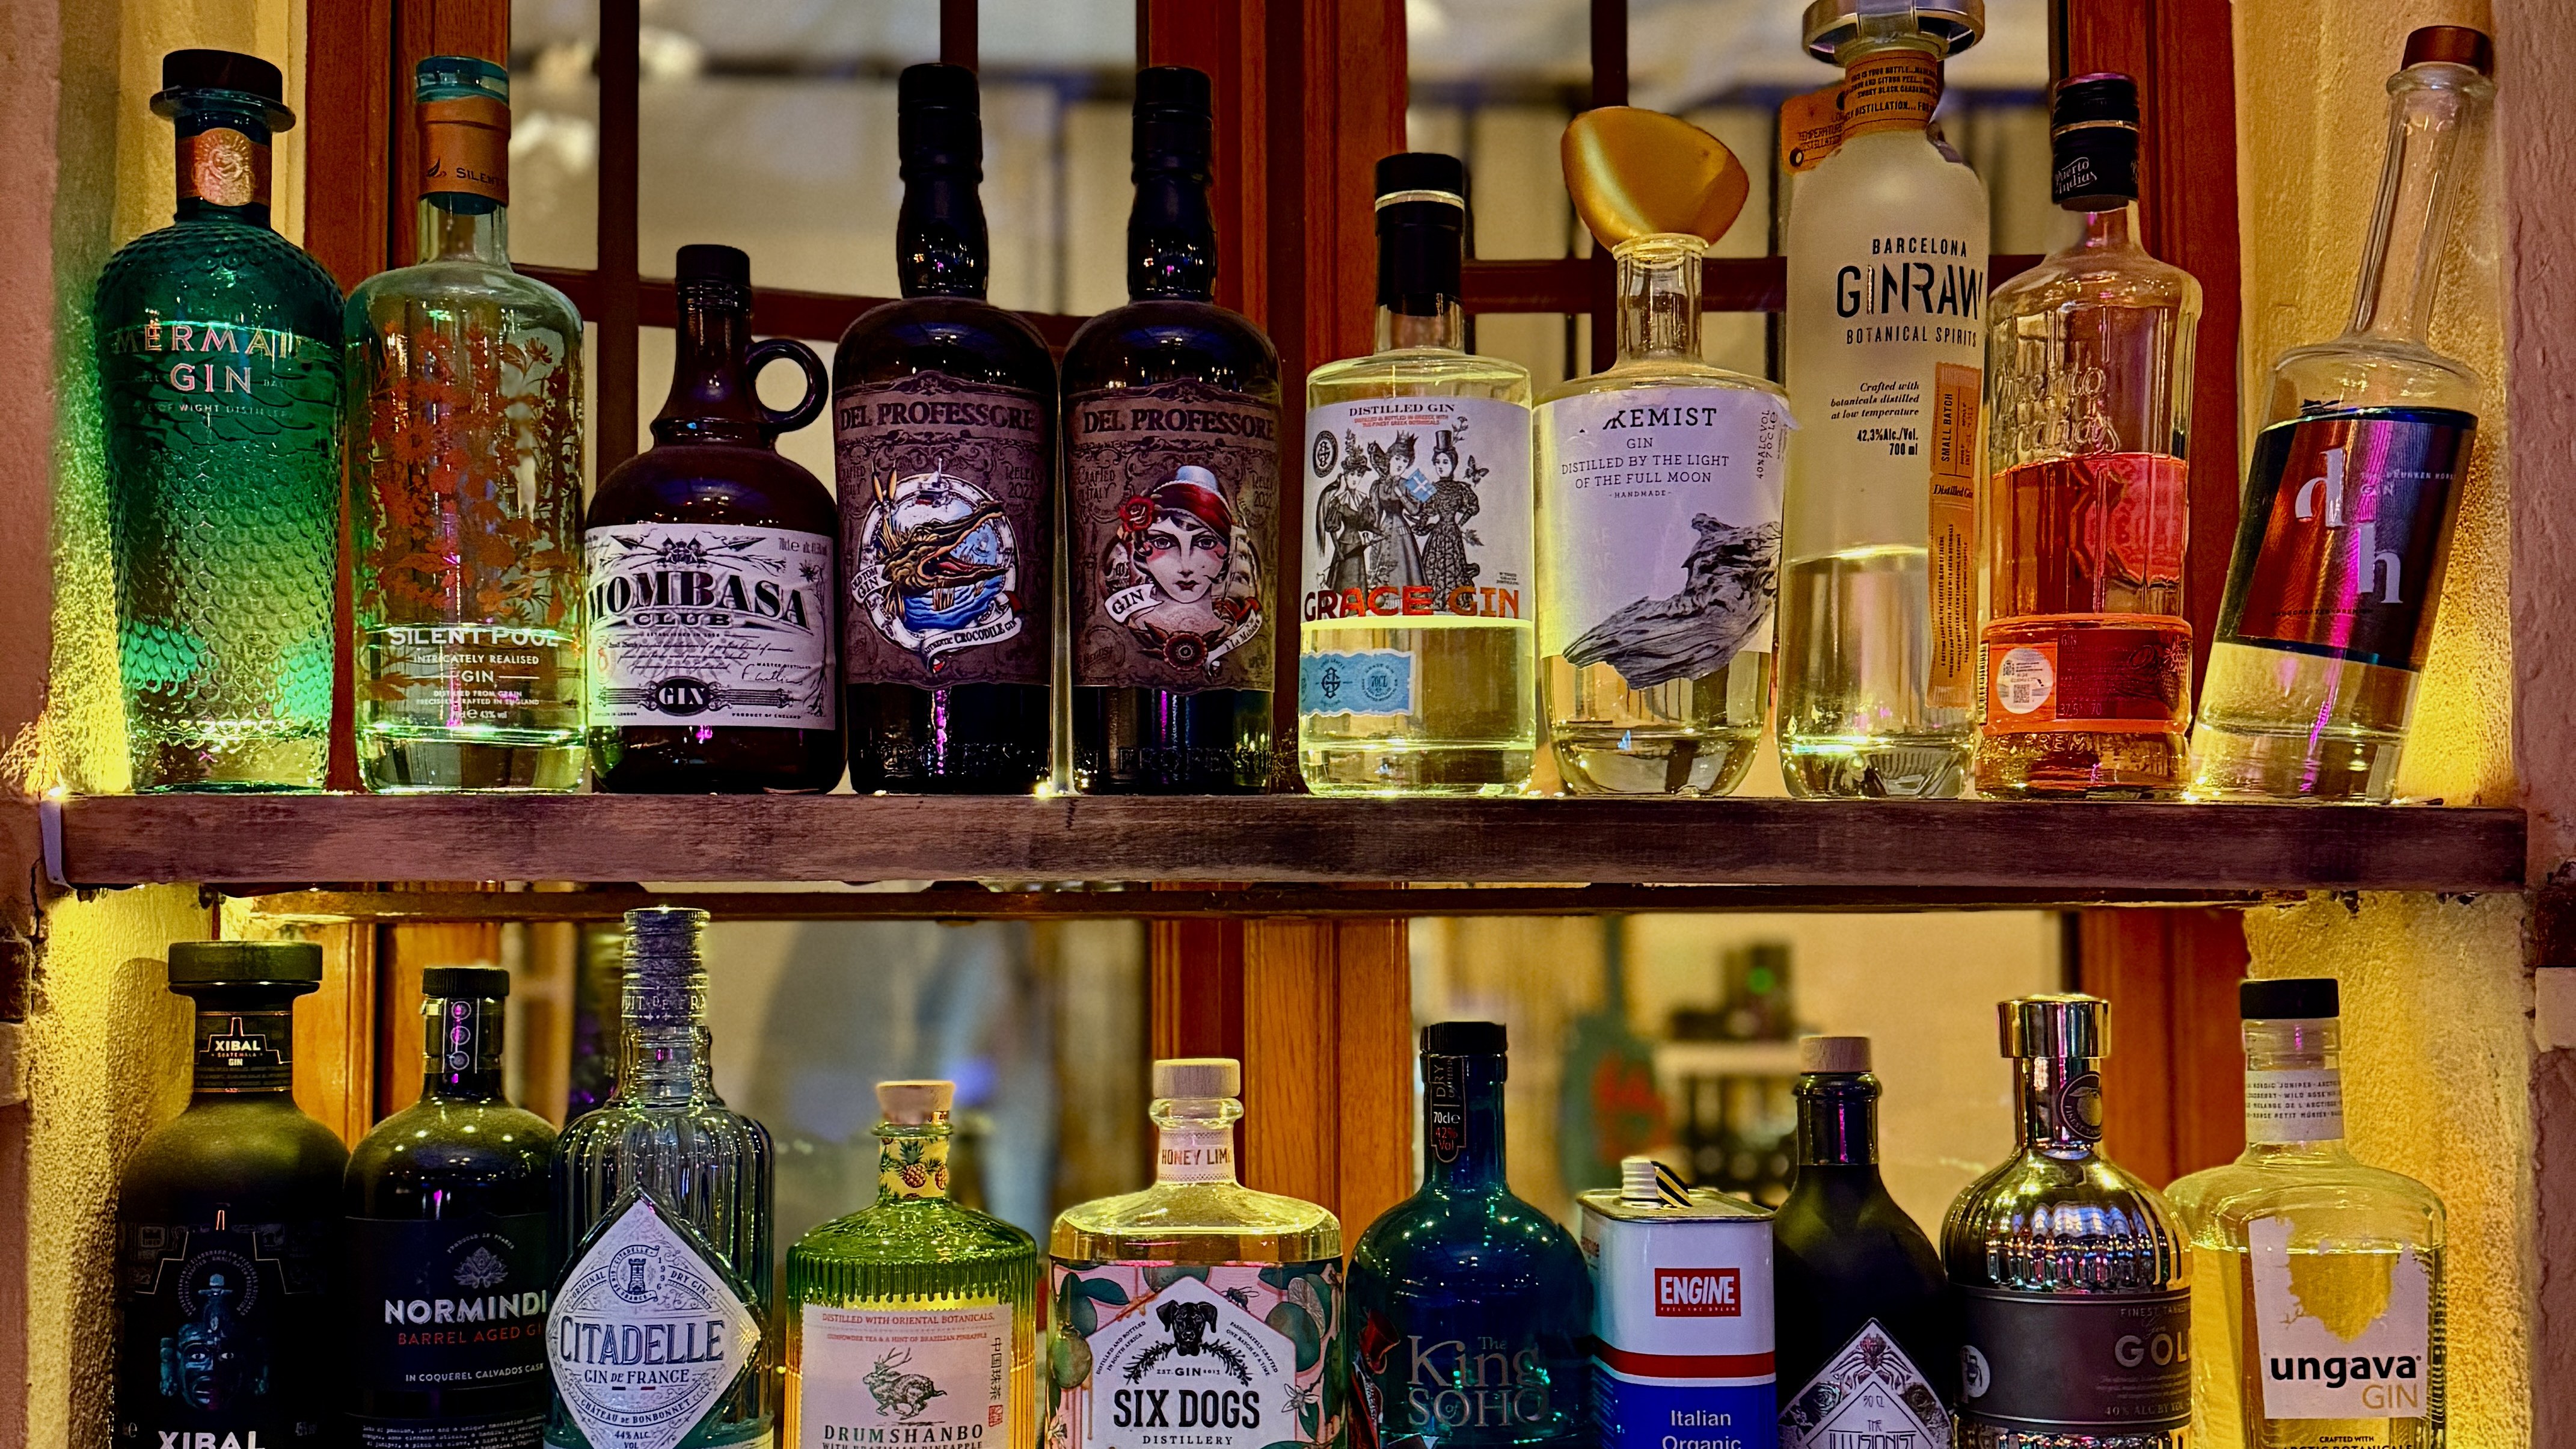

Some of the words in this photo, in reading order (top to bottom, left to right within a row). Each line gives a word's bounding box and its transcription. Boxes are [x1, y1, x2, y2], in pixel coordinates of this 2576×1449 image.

[1872, 237, 1966, 257] BARCELONA
[1836, 262, 1983, 321] GINRAW
[1847, 326, 1927, 344] BOTANICAL
[1936, 327, 1976, 348] SPIRITS
[170, 363, 253, 393] GIN
[1860, 381, 1896, 392] Crafted
[1898, 380, 1919, 391] with
[180, 404, 218, 413] WIGHT
[1349, 404, 1423, 417] DISTILLED
[1428, 404, 1455, 413] GIN
[1830, 396, 1878, 408] botanicals
[1880, 393, 1919, 405] distilled
[1943, 393, 1953, 426] BATCH
[841, 404, 872, 431] DEL
[877, 401, 1035, 431] PROFESSORE
[1083, 410, 1125, 434] DEL
[1131, 408, 1275, 440] PROFESSORE
[1760, 410, 1770, 432] VOL
[1831, 411, 1840, 420] at
[1842, 410, 1859, 420] low
[1862, 407, 1919, 421] temperature
[1626, 437, 1654, 449] GIN
[1889, 442, 1906, 456] 700
[1941, 428, 1952, 462] SMALL
[1562, 458, 1624, 475] DISTILLED
[1628, 455, 1648, 467] BY
[1653, 454, 1682, 466] THE
[1687, 454, 1729, 466] LIGHT
[1575, 476, 1590, 489] OF
[1595, 473, 1621, 487] THE
[1626, 472, 1662, 484] FULL
[1667, 471, 1711, 483] MOON
[2361, 483, 2393, 496] GN
[1933, 484, 1964, 497] Distilled
[863, 567, 878, 582] TOM
[857, 576, 879, 599] GIN
[1112, 589, 1144, 615] GIN
[1305, 585, 1434, 622] GRACE
[1446, 586, 1519, 619] GIN
[633, 612, 732, 627] CLUB
[390, 626, 481, 646] SILENT
[954, 623, 1004, 644] CROCODILE
[413, 654, 485, 664] INTRICATELY
[489, 654, 539, 665] REALISED
[461, 669, 494, 683] GIN
[658, 687, 705, 706] GIN
[215, 1039, 261, 1051] XIBAL
[228, 1058, 243, 1066] GIN
[1434, 1064, 1446, 1097] DRY
[1439, 1139, 1454, 1151] Vol
[1162, 1149, 1201, 1166] HONEY
[572, 1271, 607, 1299] ORIGINAL
[670, 1270, 690, 1284] DRY
[691, 1279, 708, 1295] GIN
[1660, 1276, 1735, 1305] ENGINE
[384, 1289, 548, 1325] NORMINDI
[2121, 1307, 2160, 1317] FINEST
[823, 1312, 863, 1324] DISTILLED
[865, 1316, 889, 1324] WITH
[892, 1315, 939, 1325] ORIENTAL
[397, 1331, 467, 1346] BARREL
[474, 1326, 521, 1343] AGED
[526, 1323, 542, 1337] GI
[559, 1315, 725, 1366] CITADELLE
[1112, 1337, 1124, 1350] AND
[1123, 1320, 1147, 1340] BOTTLED
[1478, 1336, 1507, 1350] The
[1111, 1347, 1126, 1365] SOUTH
[1124, 1332, 1144, 1351] AFRICA
[2115, 1331, 2191, 1368] GOL
[1407, 1334, 1542, 1388] King
[419, 1372, 473, 1383] COQUEREL
[475, 1365, 523, 1380] CALVADOS
[584, 1370, 608, 1383] GIN
[610, 1373, 624, 1383] DE
[627, 1369, 690, 1384] FRANCE
[1174, 1367, 1201, 1377] GIN
[2270, 1355, 2417, 1389] ungava
[2362, 1383, 2418, 1410] GIN
[580, 1398, 618, 1423] CHÂTEAU
[633, 1398, 691, 1425] BONBONNET
[1113, 1389, 1170, 1429] SIX
[1179, 1389, 1260, 1429] DOGS
[1408, 1387, 1551, 1427] SOHO
[1671, 1409, 1732, 1427] Italian
[158, 1430, 266, 1449] XIBAL
[614, 1430, 632, 1440] 44%
[633, 1431, 649, 1439] ALC
[824, 1424, 983, 1444] DRUMSHANBO
[1143, 1435, 1233, 1445] DISTILLERY
[1661, 1435, 1741, 1449] Organic
